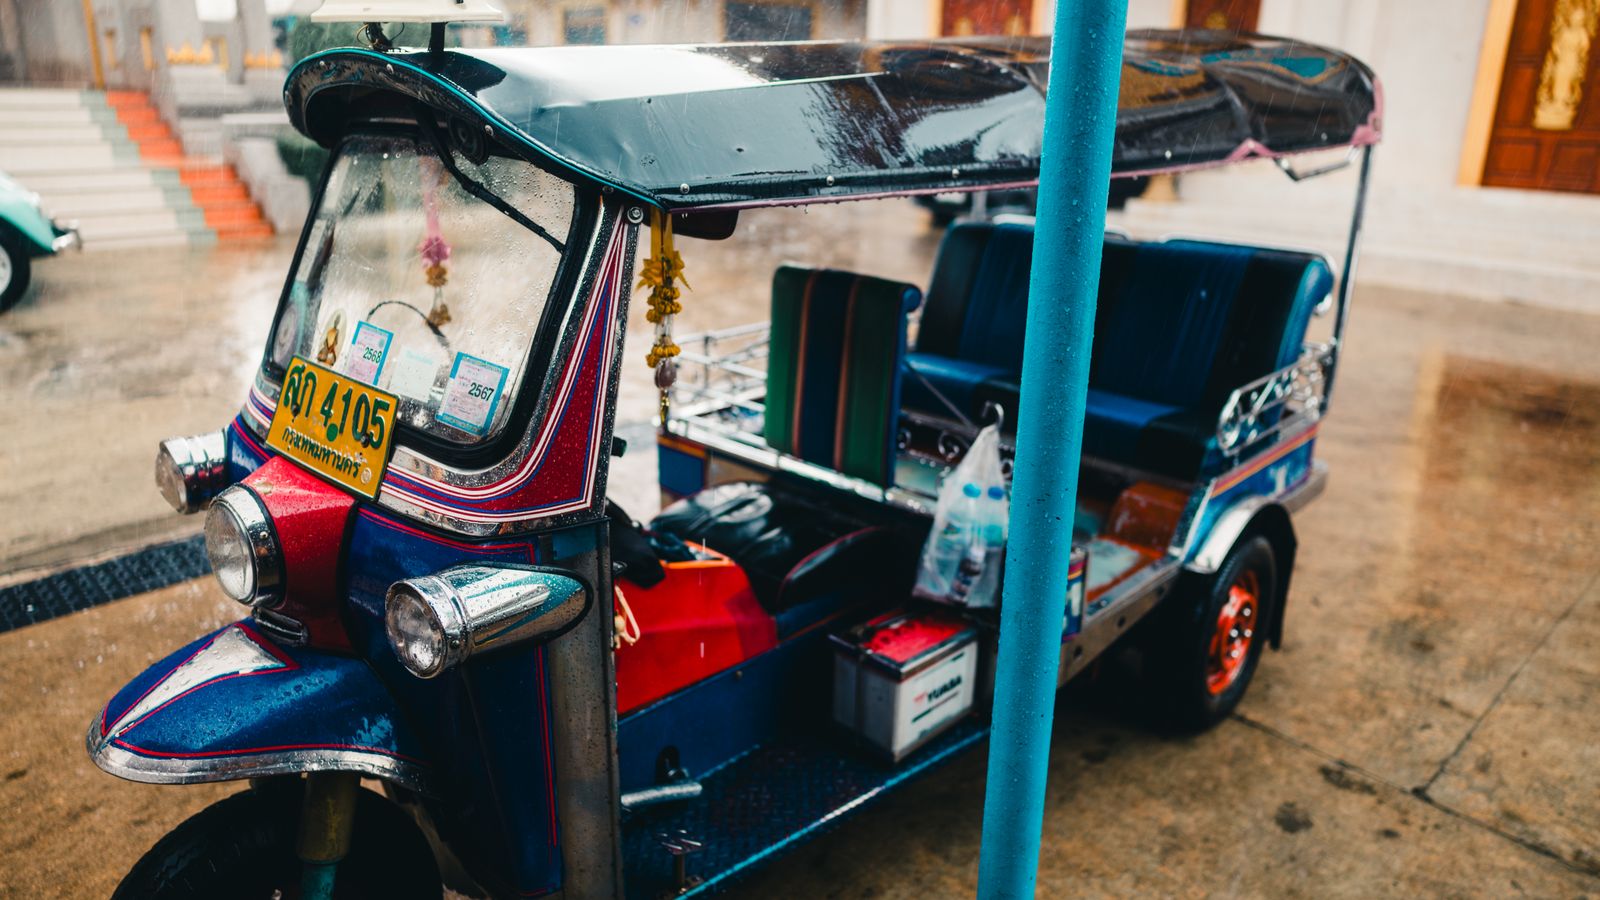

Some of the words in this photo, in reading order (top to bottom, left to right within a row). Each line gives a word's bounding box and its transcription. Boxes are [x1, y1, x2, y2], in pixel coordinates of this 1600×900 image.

[363, 346, 382, 364] 2568
[468, 382, 495, 402] 2567
[320, 381, 390, 449] 4105
[282, 426, 361, 478] กรุงเทพมหานคร
